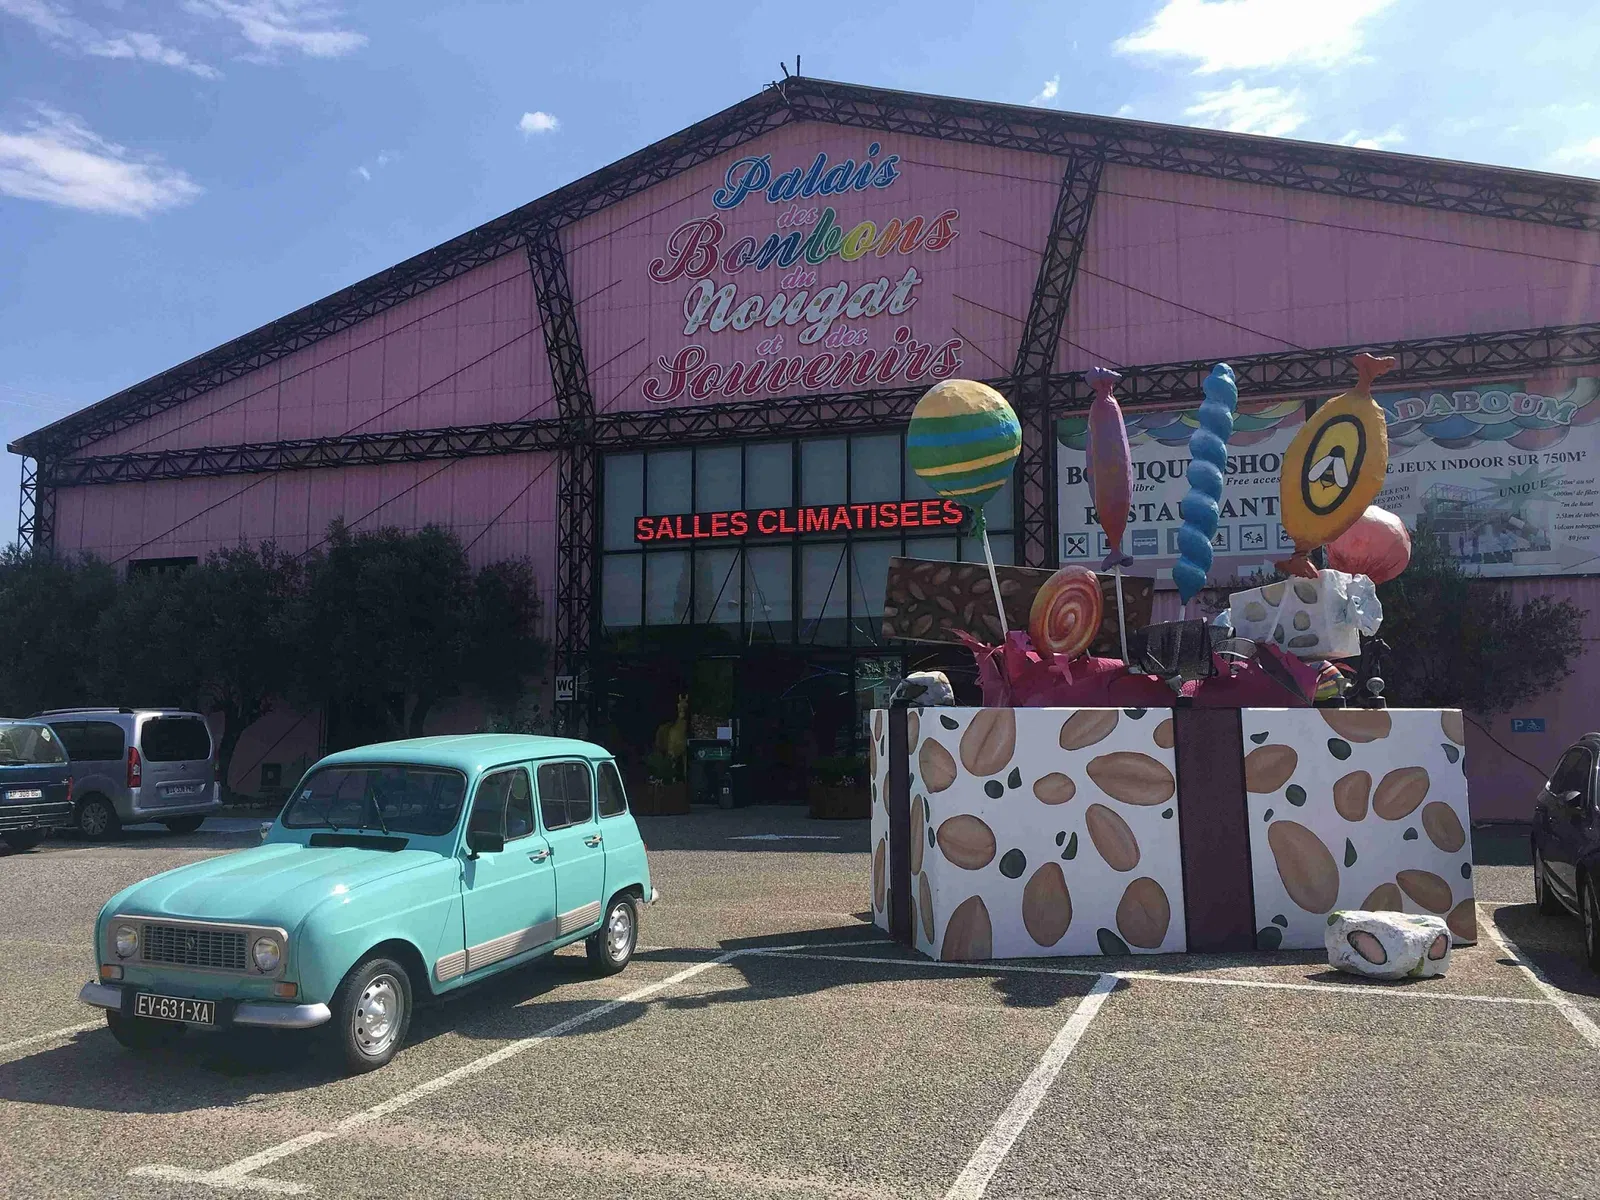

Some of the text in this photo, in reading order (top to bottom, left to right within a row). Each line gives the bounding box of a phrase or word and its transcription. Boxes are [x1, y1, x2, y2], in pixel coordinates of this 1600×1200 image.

[713, 142, 900, 210] Palais
[777, 204, 819, 229] des
[648, 206, 959, 284] Bonbons
[781, 267, 816, 289] du
[683, 267, 923, 345] Nougat
[756, 325, 868, 355] et des
[642, 326, 964, 402] Souvenirs
[1224, 452, 1284, 475] SHO
[1398, 461, 1437, 473] JEUX
[1442, 456, 1504, 471] INDOOR
[1508, 453, 1539, 467] SUR
[1132, 484, 1155, 492] libre
[1226, 476, 1280, 486] Free acces
[1500, 478, 1548, 498] UNIQUE
[637, 500, 964, 541] SALLES CLIMATISEES
[1084, 496, 1280, 525] RSTAANT
[1514, 720, 1524, 731] P
[138, 996, 209, 1023] EV-631-XA
